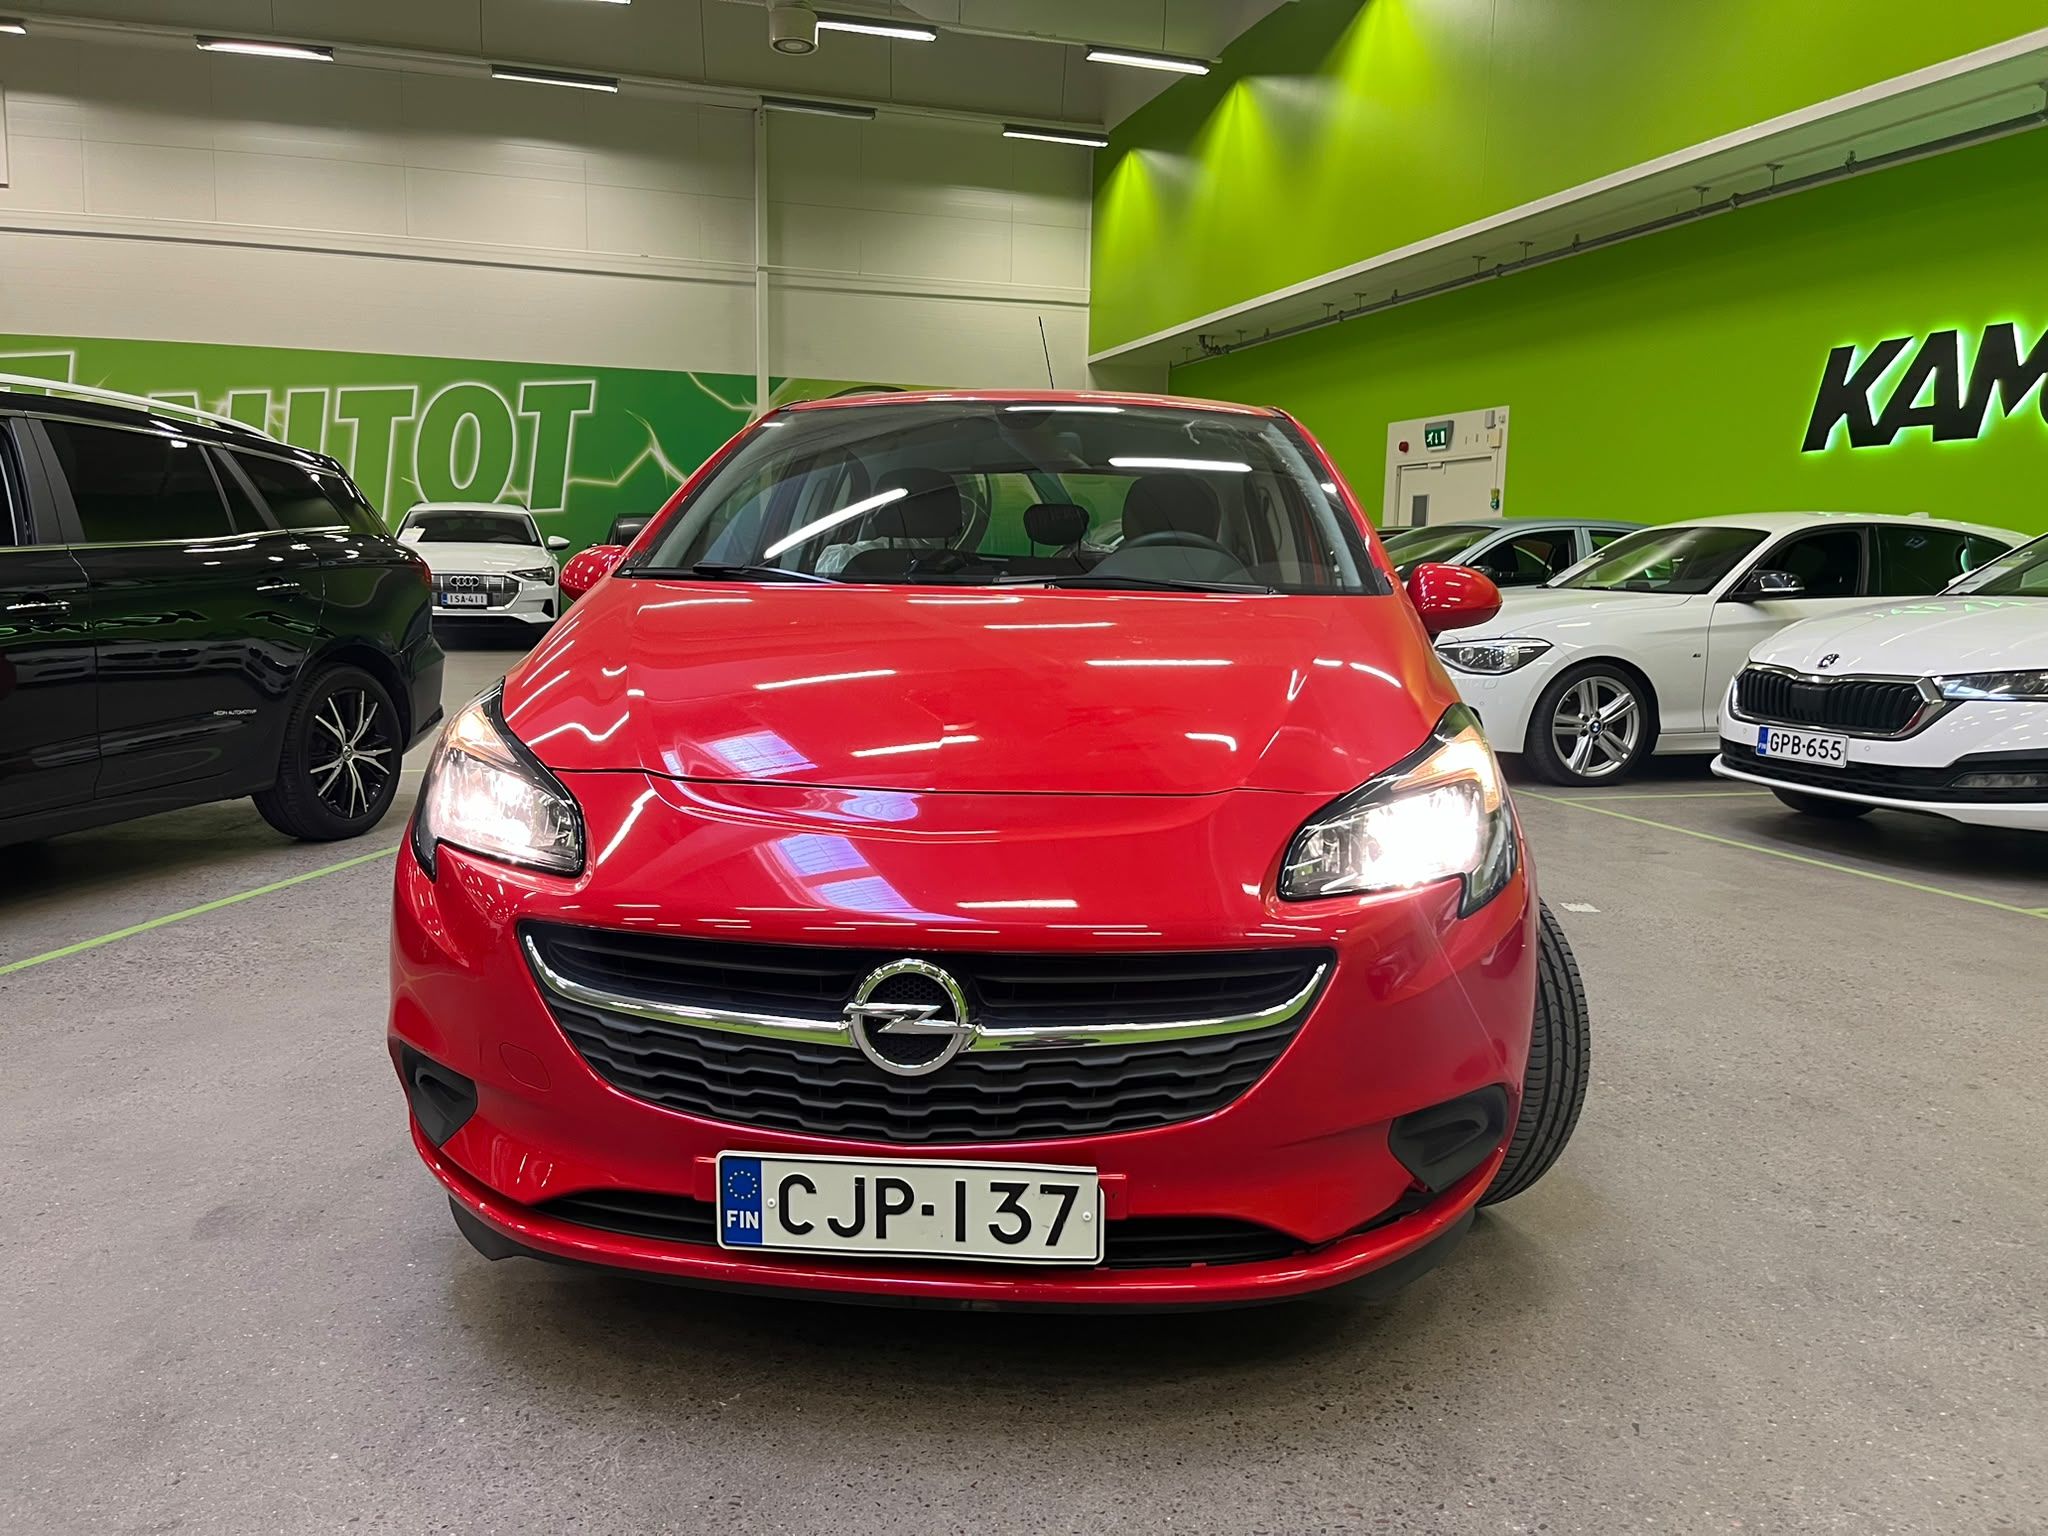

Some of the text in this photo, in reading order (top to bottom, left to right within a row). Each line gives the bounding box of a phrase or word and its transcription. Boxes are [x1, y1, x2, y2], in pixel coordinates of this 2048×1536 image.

[1801, 322, 2048, 453] KAM
[1770, 732, 1842, 760] GPB-655
[726, 1173, 1080, 1247] FIN CJP-137
